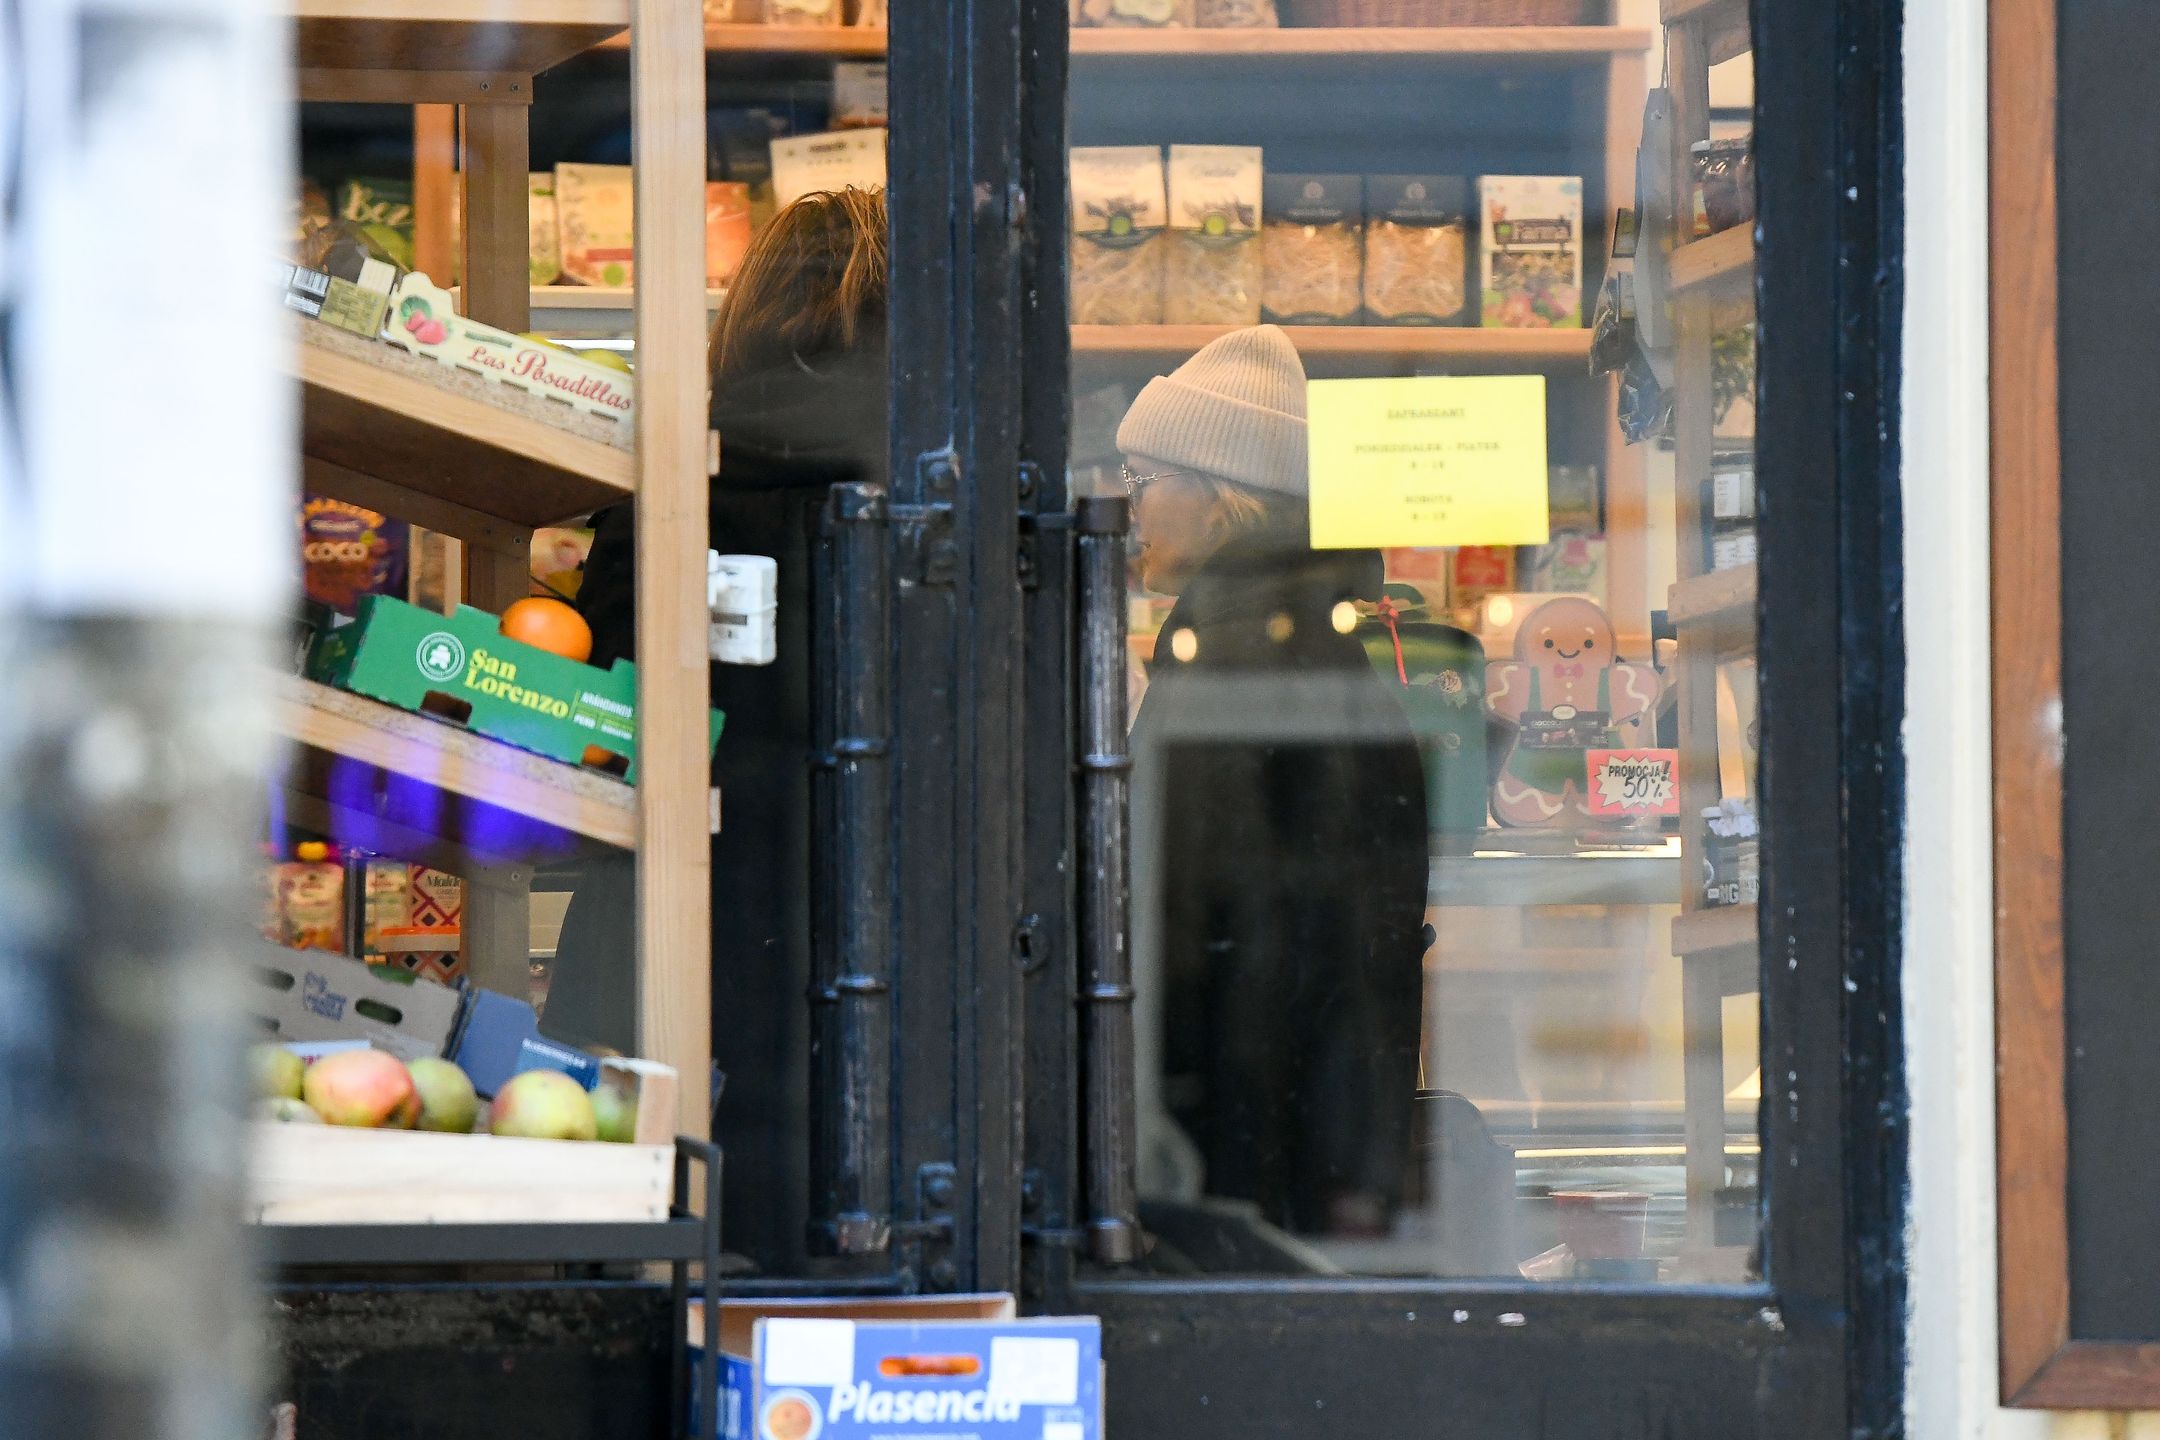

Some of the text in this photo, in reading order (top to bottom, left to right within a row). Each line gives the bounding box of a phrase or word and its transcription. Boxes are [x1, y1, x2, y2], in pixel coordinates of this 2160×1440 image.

[467, 345, 632, 410] Las Posadillas
[470, 648, 517, 682] San
[464, 667, 570, 719] Lorenzo
[1623, 773, 1663, 799] 50%
[827, 1380, 1022, 1424] Plasencia
